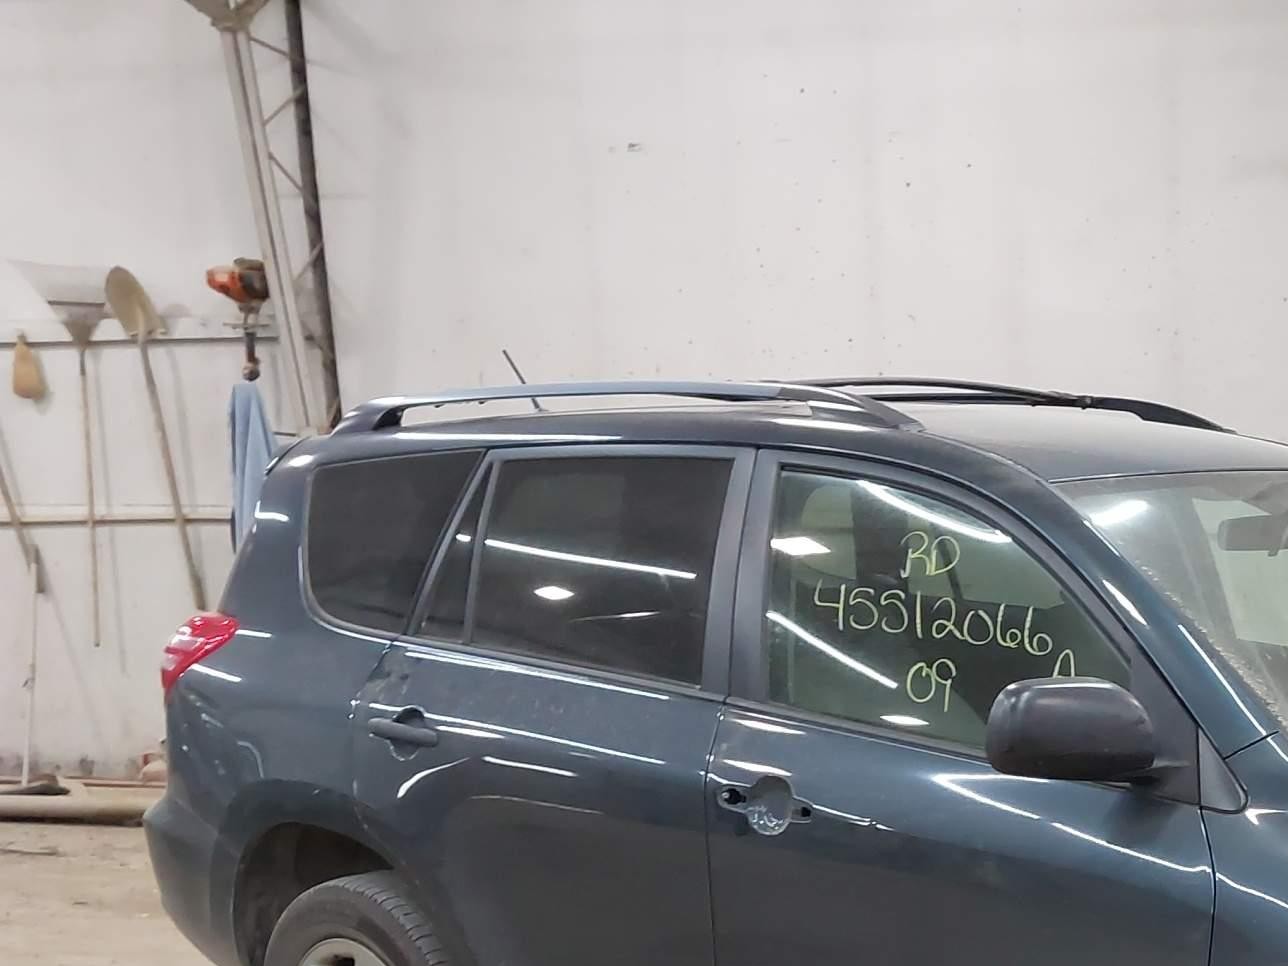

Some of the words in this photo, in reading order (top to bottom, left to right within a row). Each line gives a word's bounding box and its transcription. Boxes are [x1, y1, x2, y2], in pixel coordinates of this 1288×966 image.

[901, 531, 960, 578] RD
[813, 579, 1053, 656] 45512066
[906, 658, 956, 712] 09
